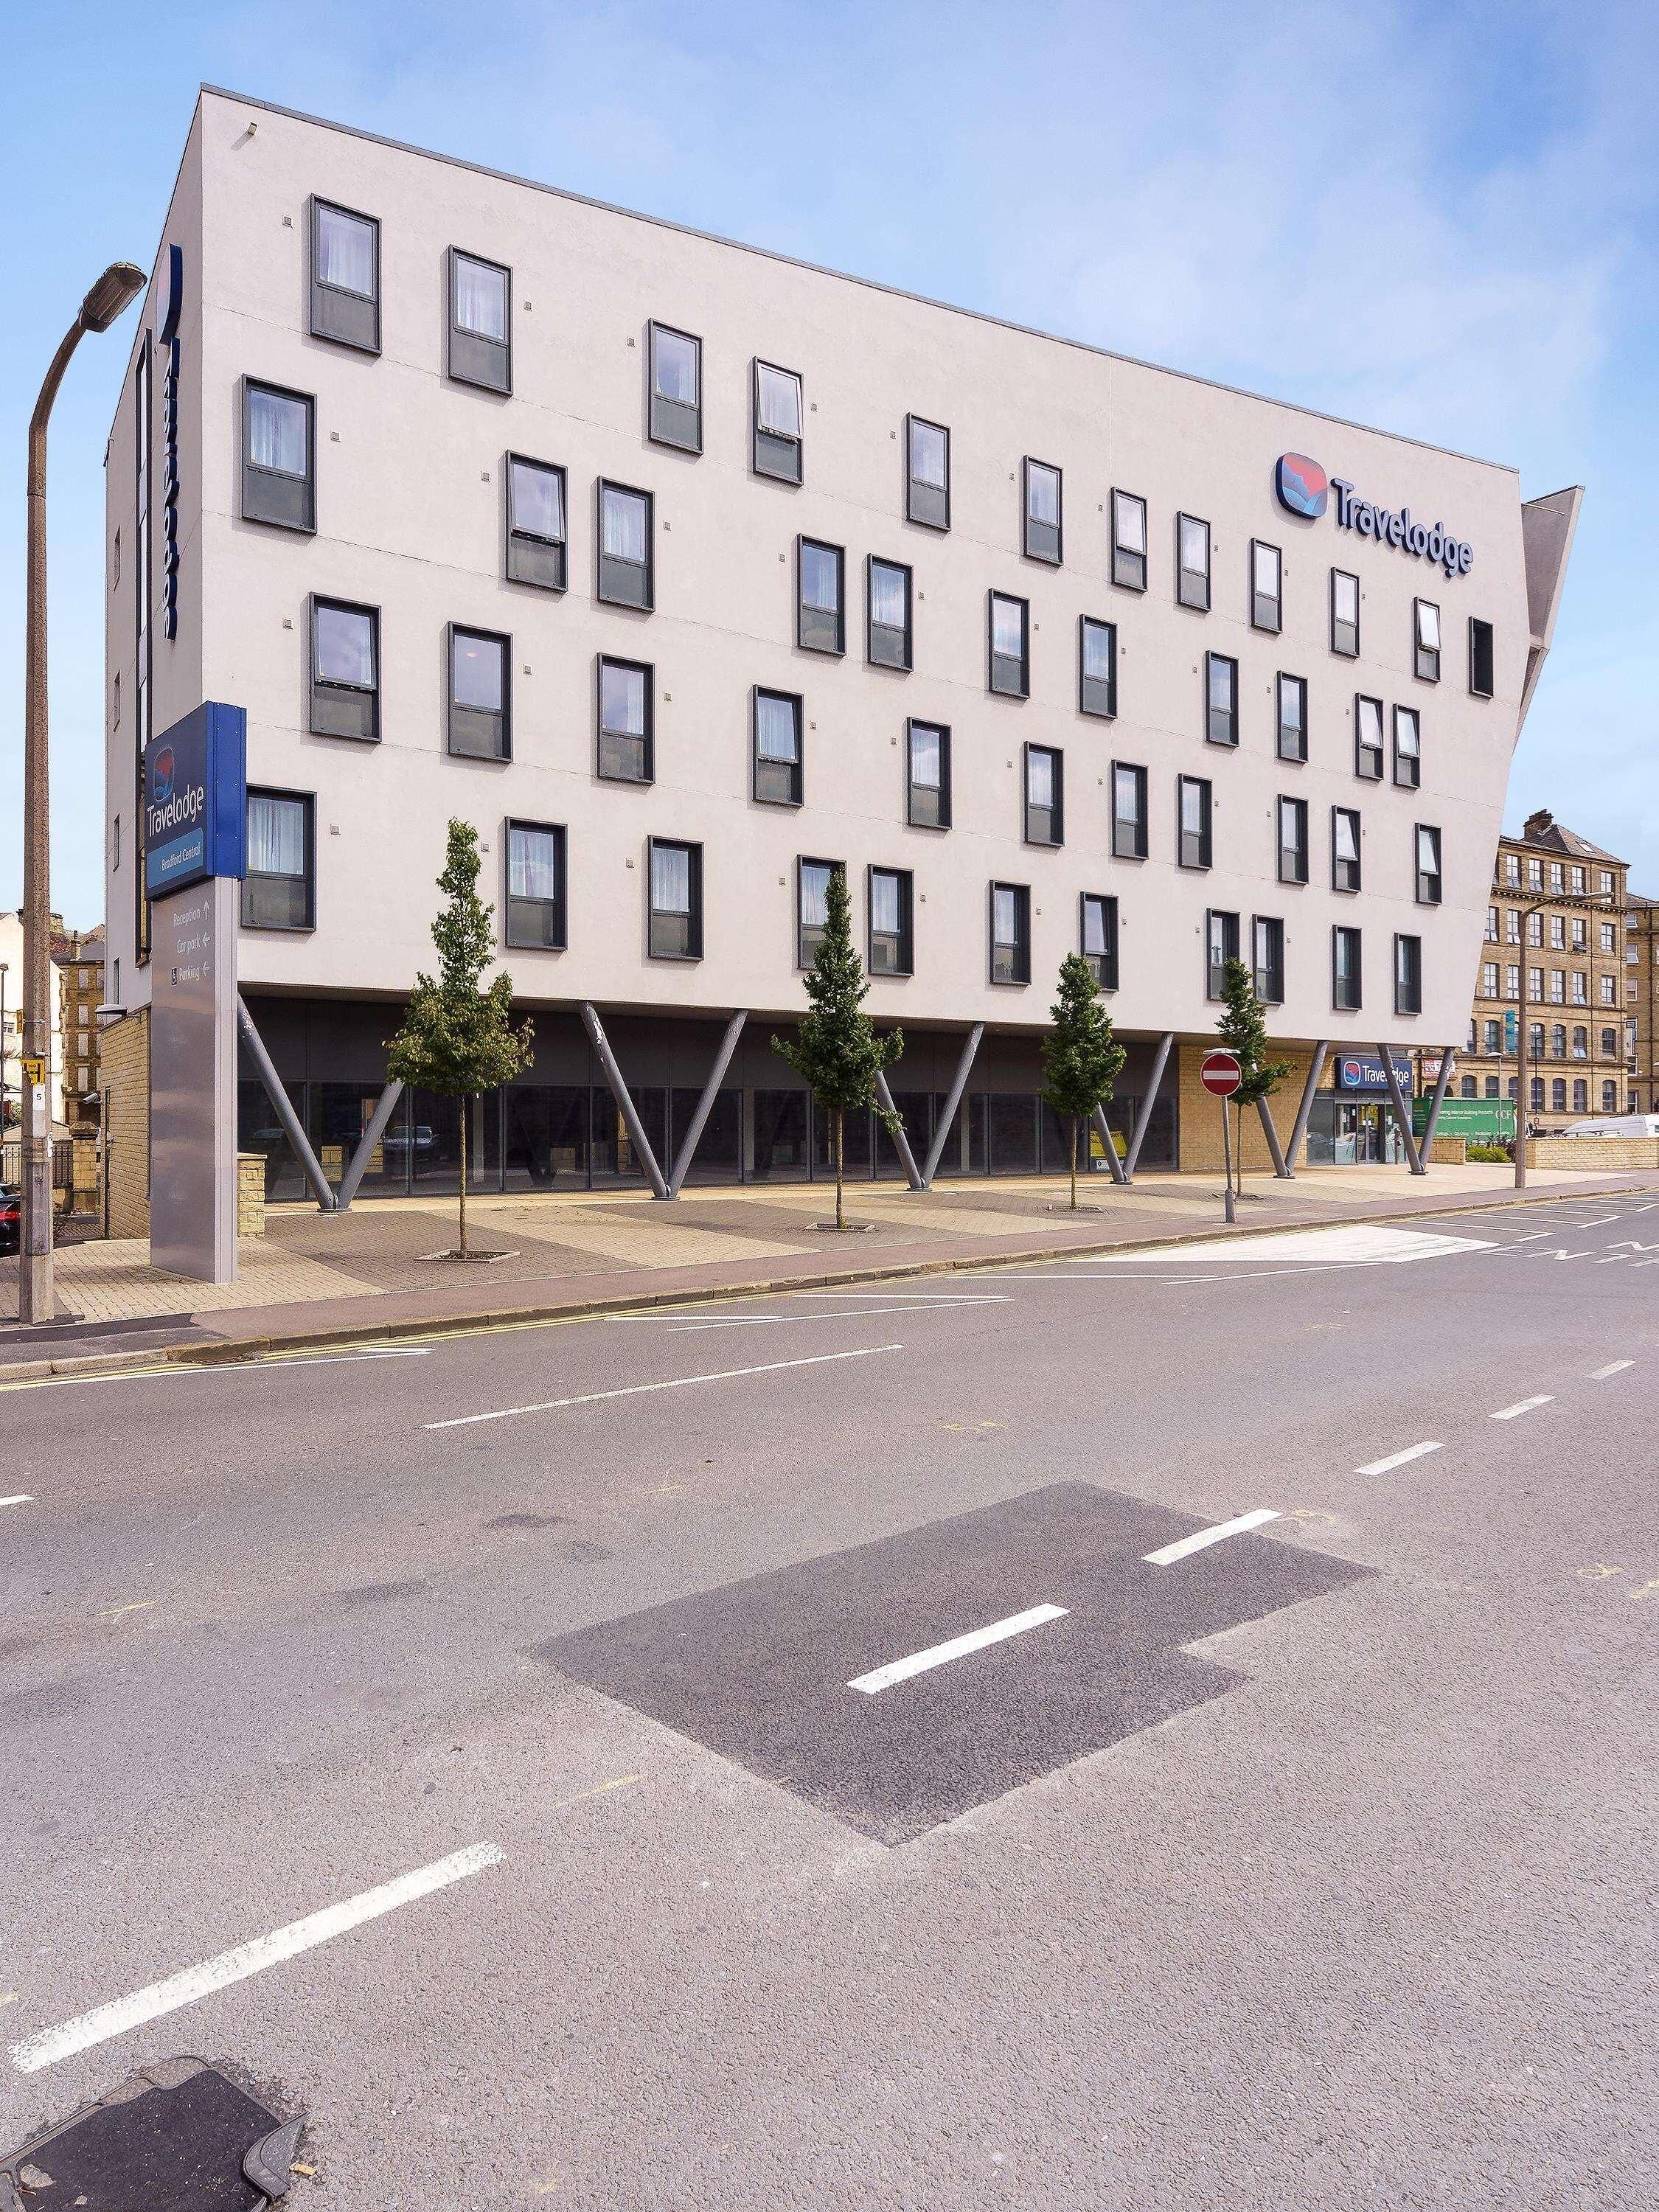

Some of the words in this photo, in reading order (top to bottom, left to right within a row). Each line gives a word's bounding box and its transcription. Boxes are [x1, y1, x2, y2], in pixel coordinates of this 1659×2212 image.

[1331, 478, 1473, 577] Travelodge
[147, 785, 204, 837] Travelodge
[161, 850, 182, 871] Bradford
[181, 841, 201, 861] Central
[173, 908, 201, 927] Reception
[179, 966, 200, 981] Parking
[1362, 1065, 1409, 1086] Travedge
